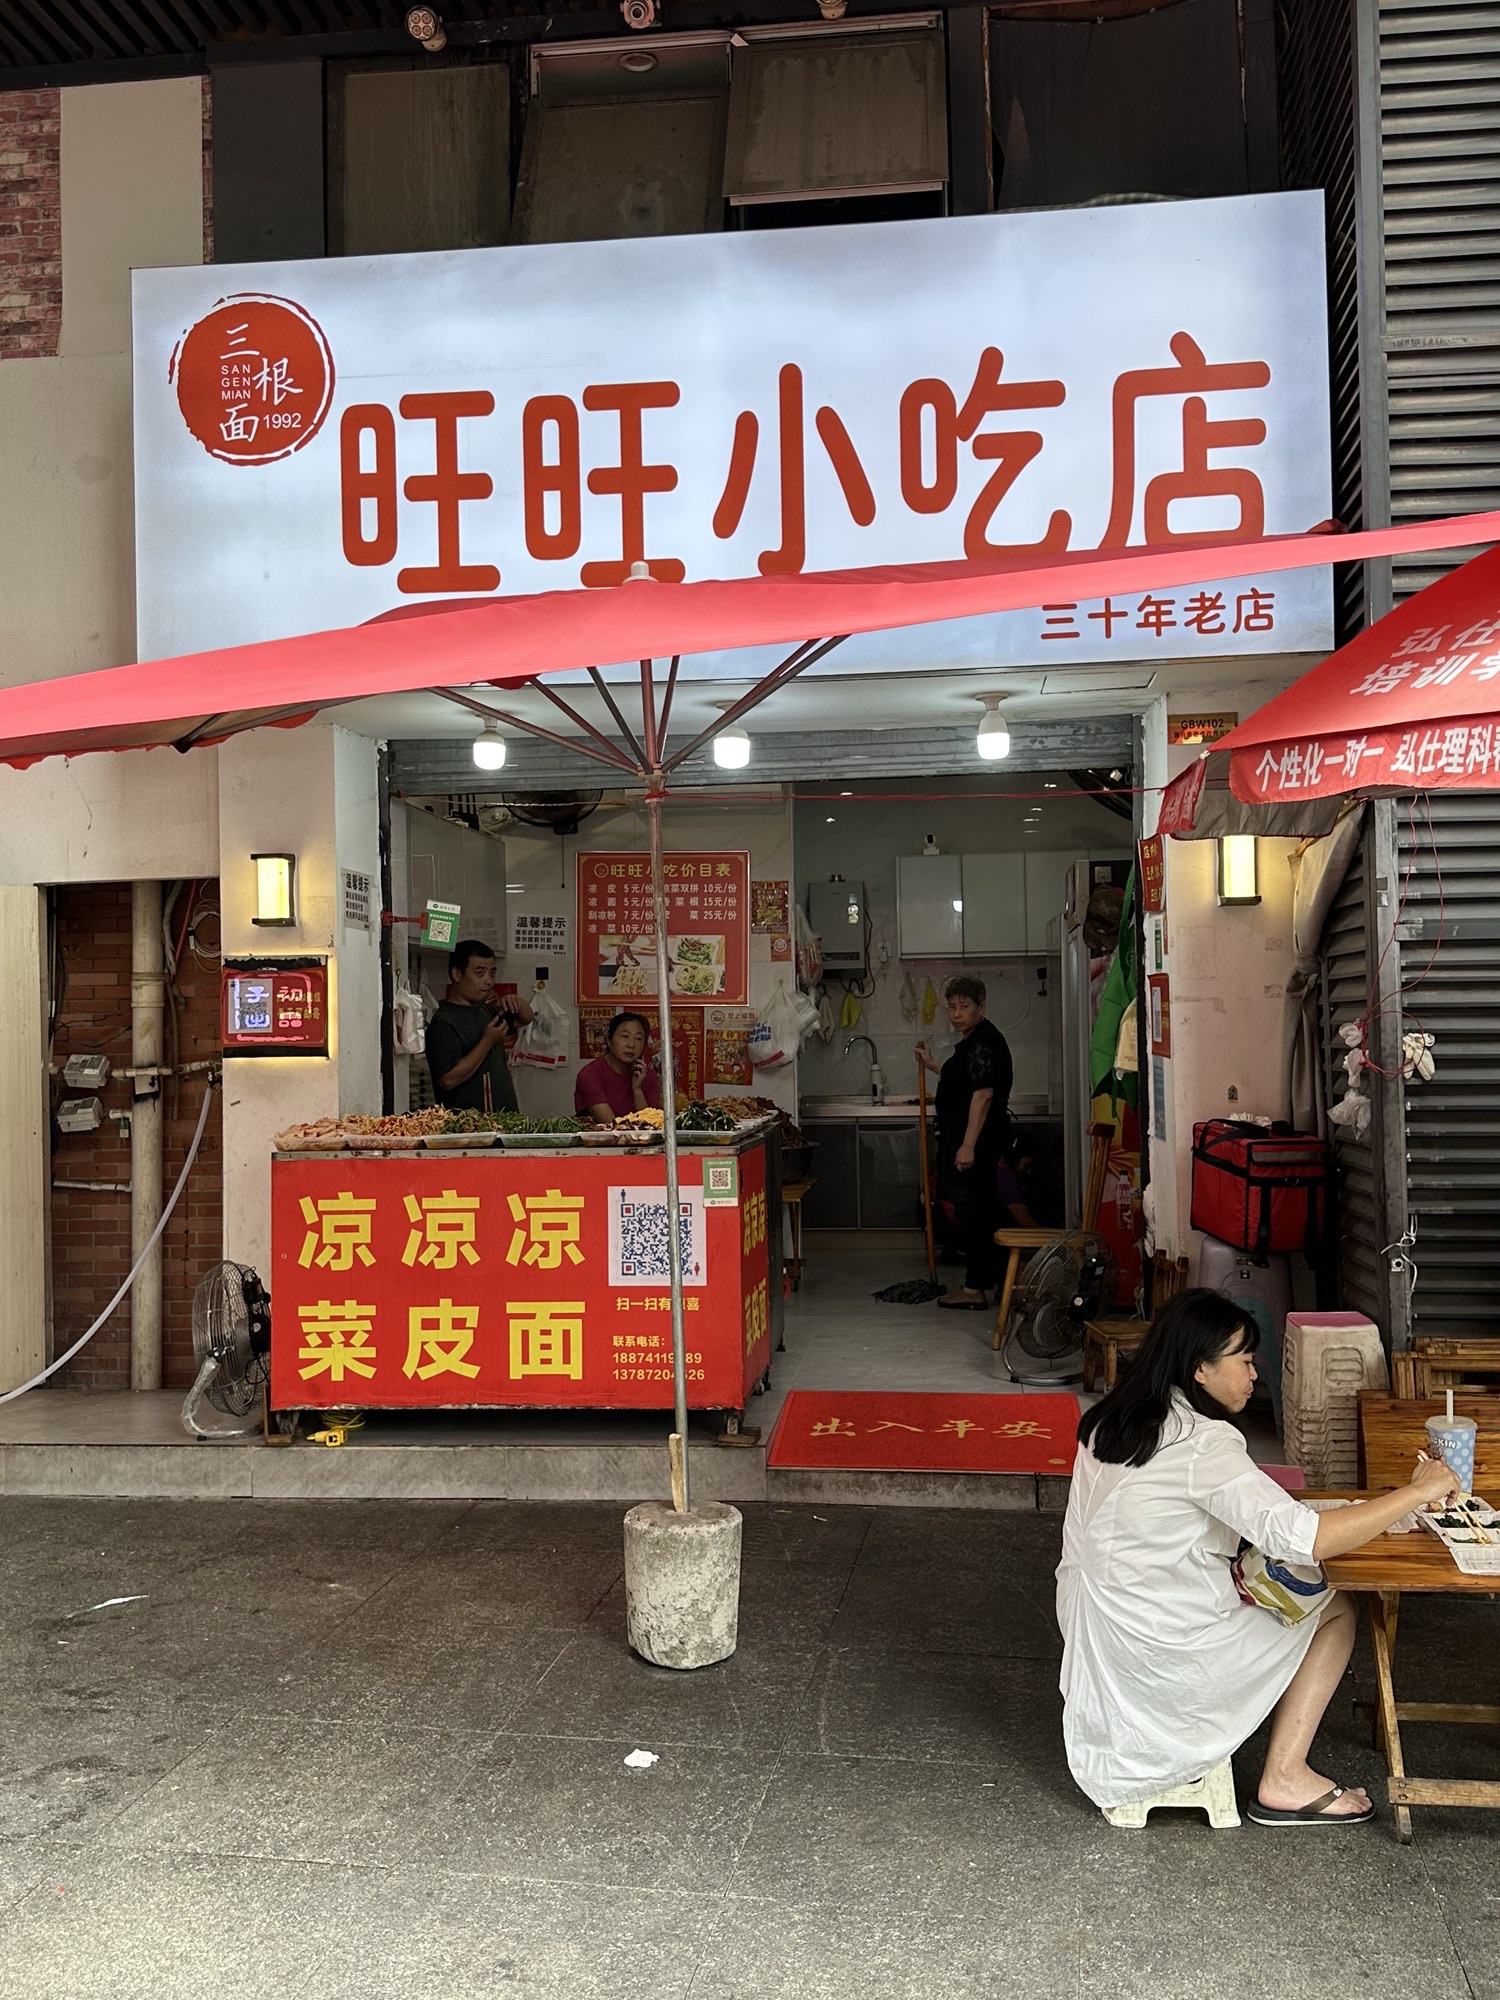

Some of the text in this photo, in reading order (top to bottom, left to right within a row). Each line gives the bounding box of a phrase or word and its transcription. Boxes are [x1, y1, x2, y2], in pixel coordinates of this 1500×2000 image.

[221, 364, 251, 375] SAN
[221, 377, 251, 388] GEN
[221, 389, 251, 400] MIAN
[263, 413, 302, 429] 1992
[340, 331, 1270, 593] 旺旺小吃店
[1040, 587, 1276, 640] 三十年老店
[1180, 718, 1225, 730] GBW102
[1255, 723, 1500, 792] 个性化一对一 弘仕理科
[588, 884, 617, 894] 凉皮
[703, 884, 737, 894] 10元/份
[588, 897, 617, 907] 凉面
[703, 897, 737, 907] 15元/份
[703, 911, 737, 921] 25元/份
[516, 916, 566, 928] 温馨提示
[588, 924, 654, 934] 凉菜 10元/份
[616, 1296, 700, 1311] 扫一扫有喜
[613, 1352, 702, 1363] 1887411989
[809, 1417, 1052, 1440] 出入平安
